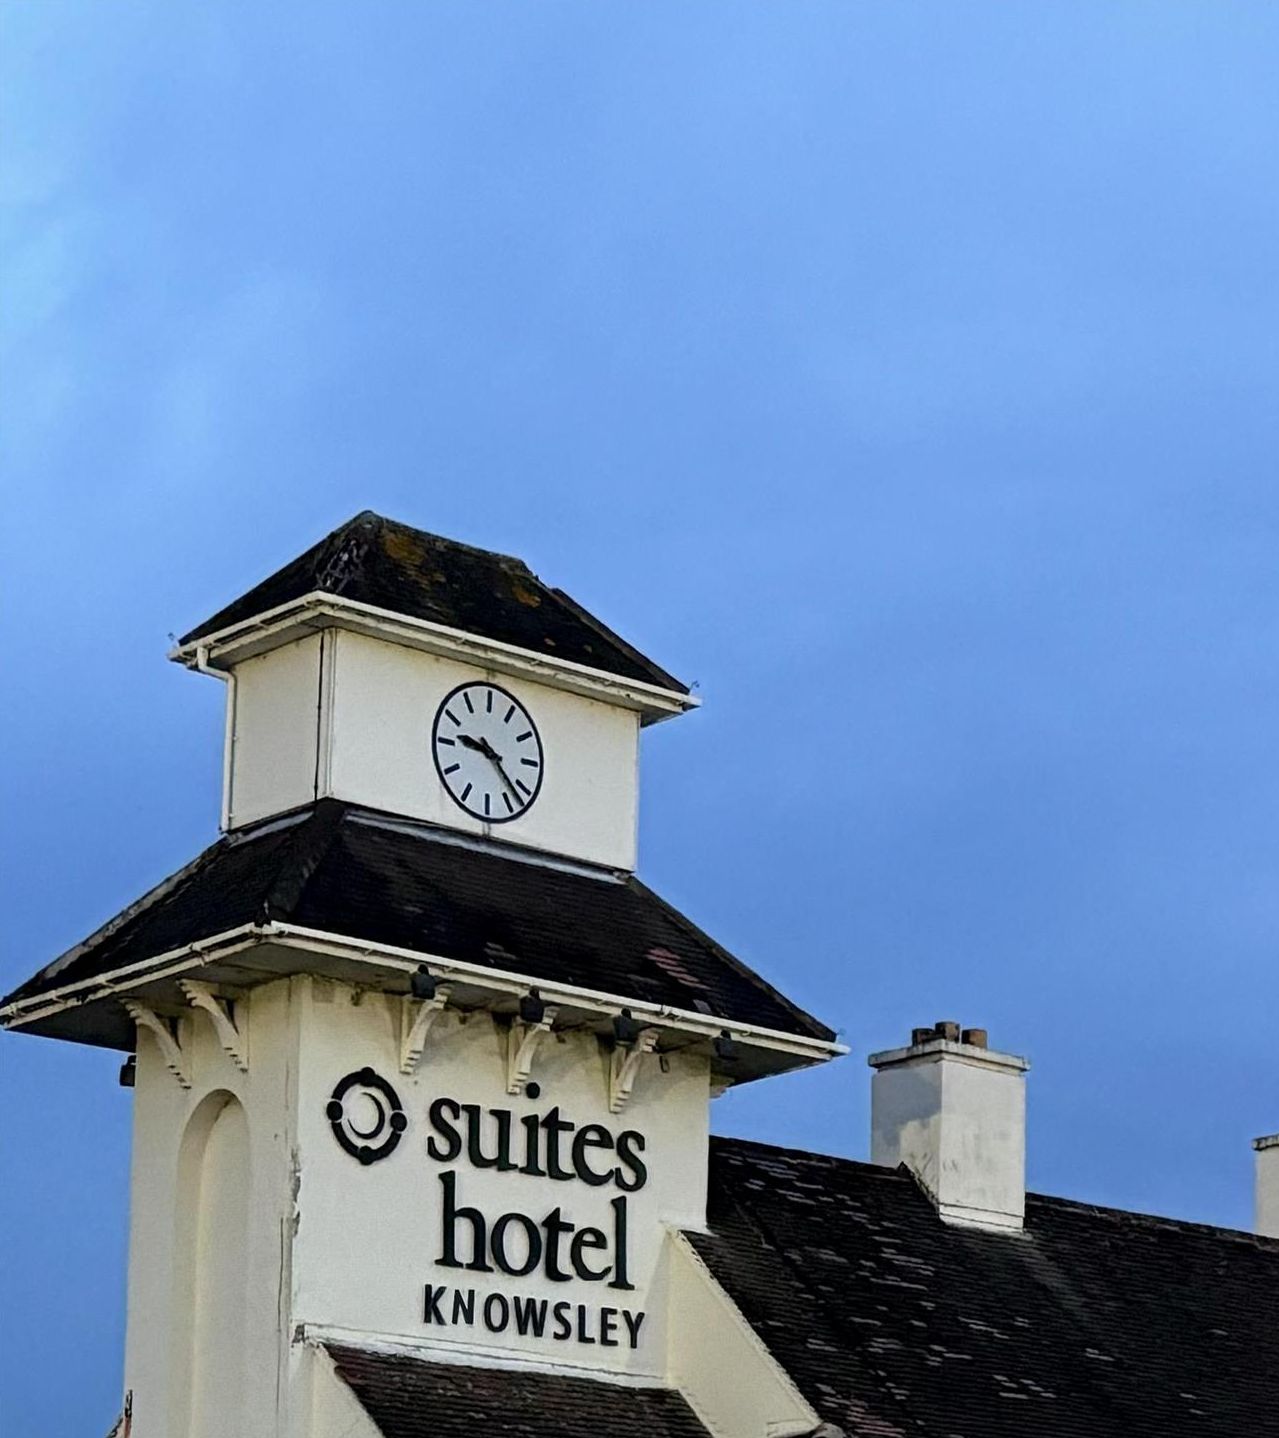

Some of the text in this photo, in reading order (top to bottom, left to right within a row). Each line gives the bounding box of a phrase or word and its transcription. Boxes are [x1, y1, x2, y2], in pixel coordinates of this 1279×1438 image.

[427, 1082, 647, 1192] suites
[434, 1170, 636, 1290] hotel
[423, 1284, 645, 1348] KNOWSLEY
